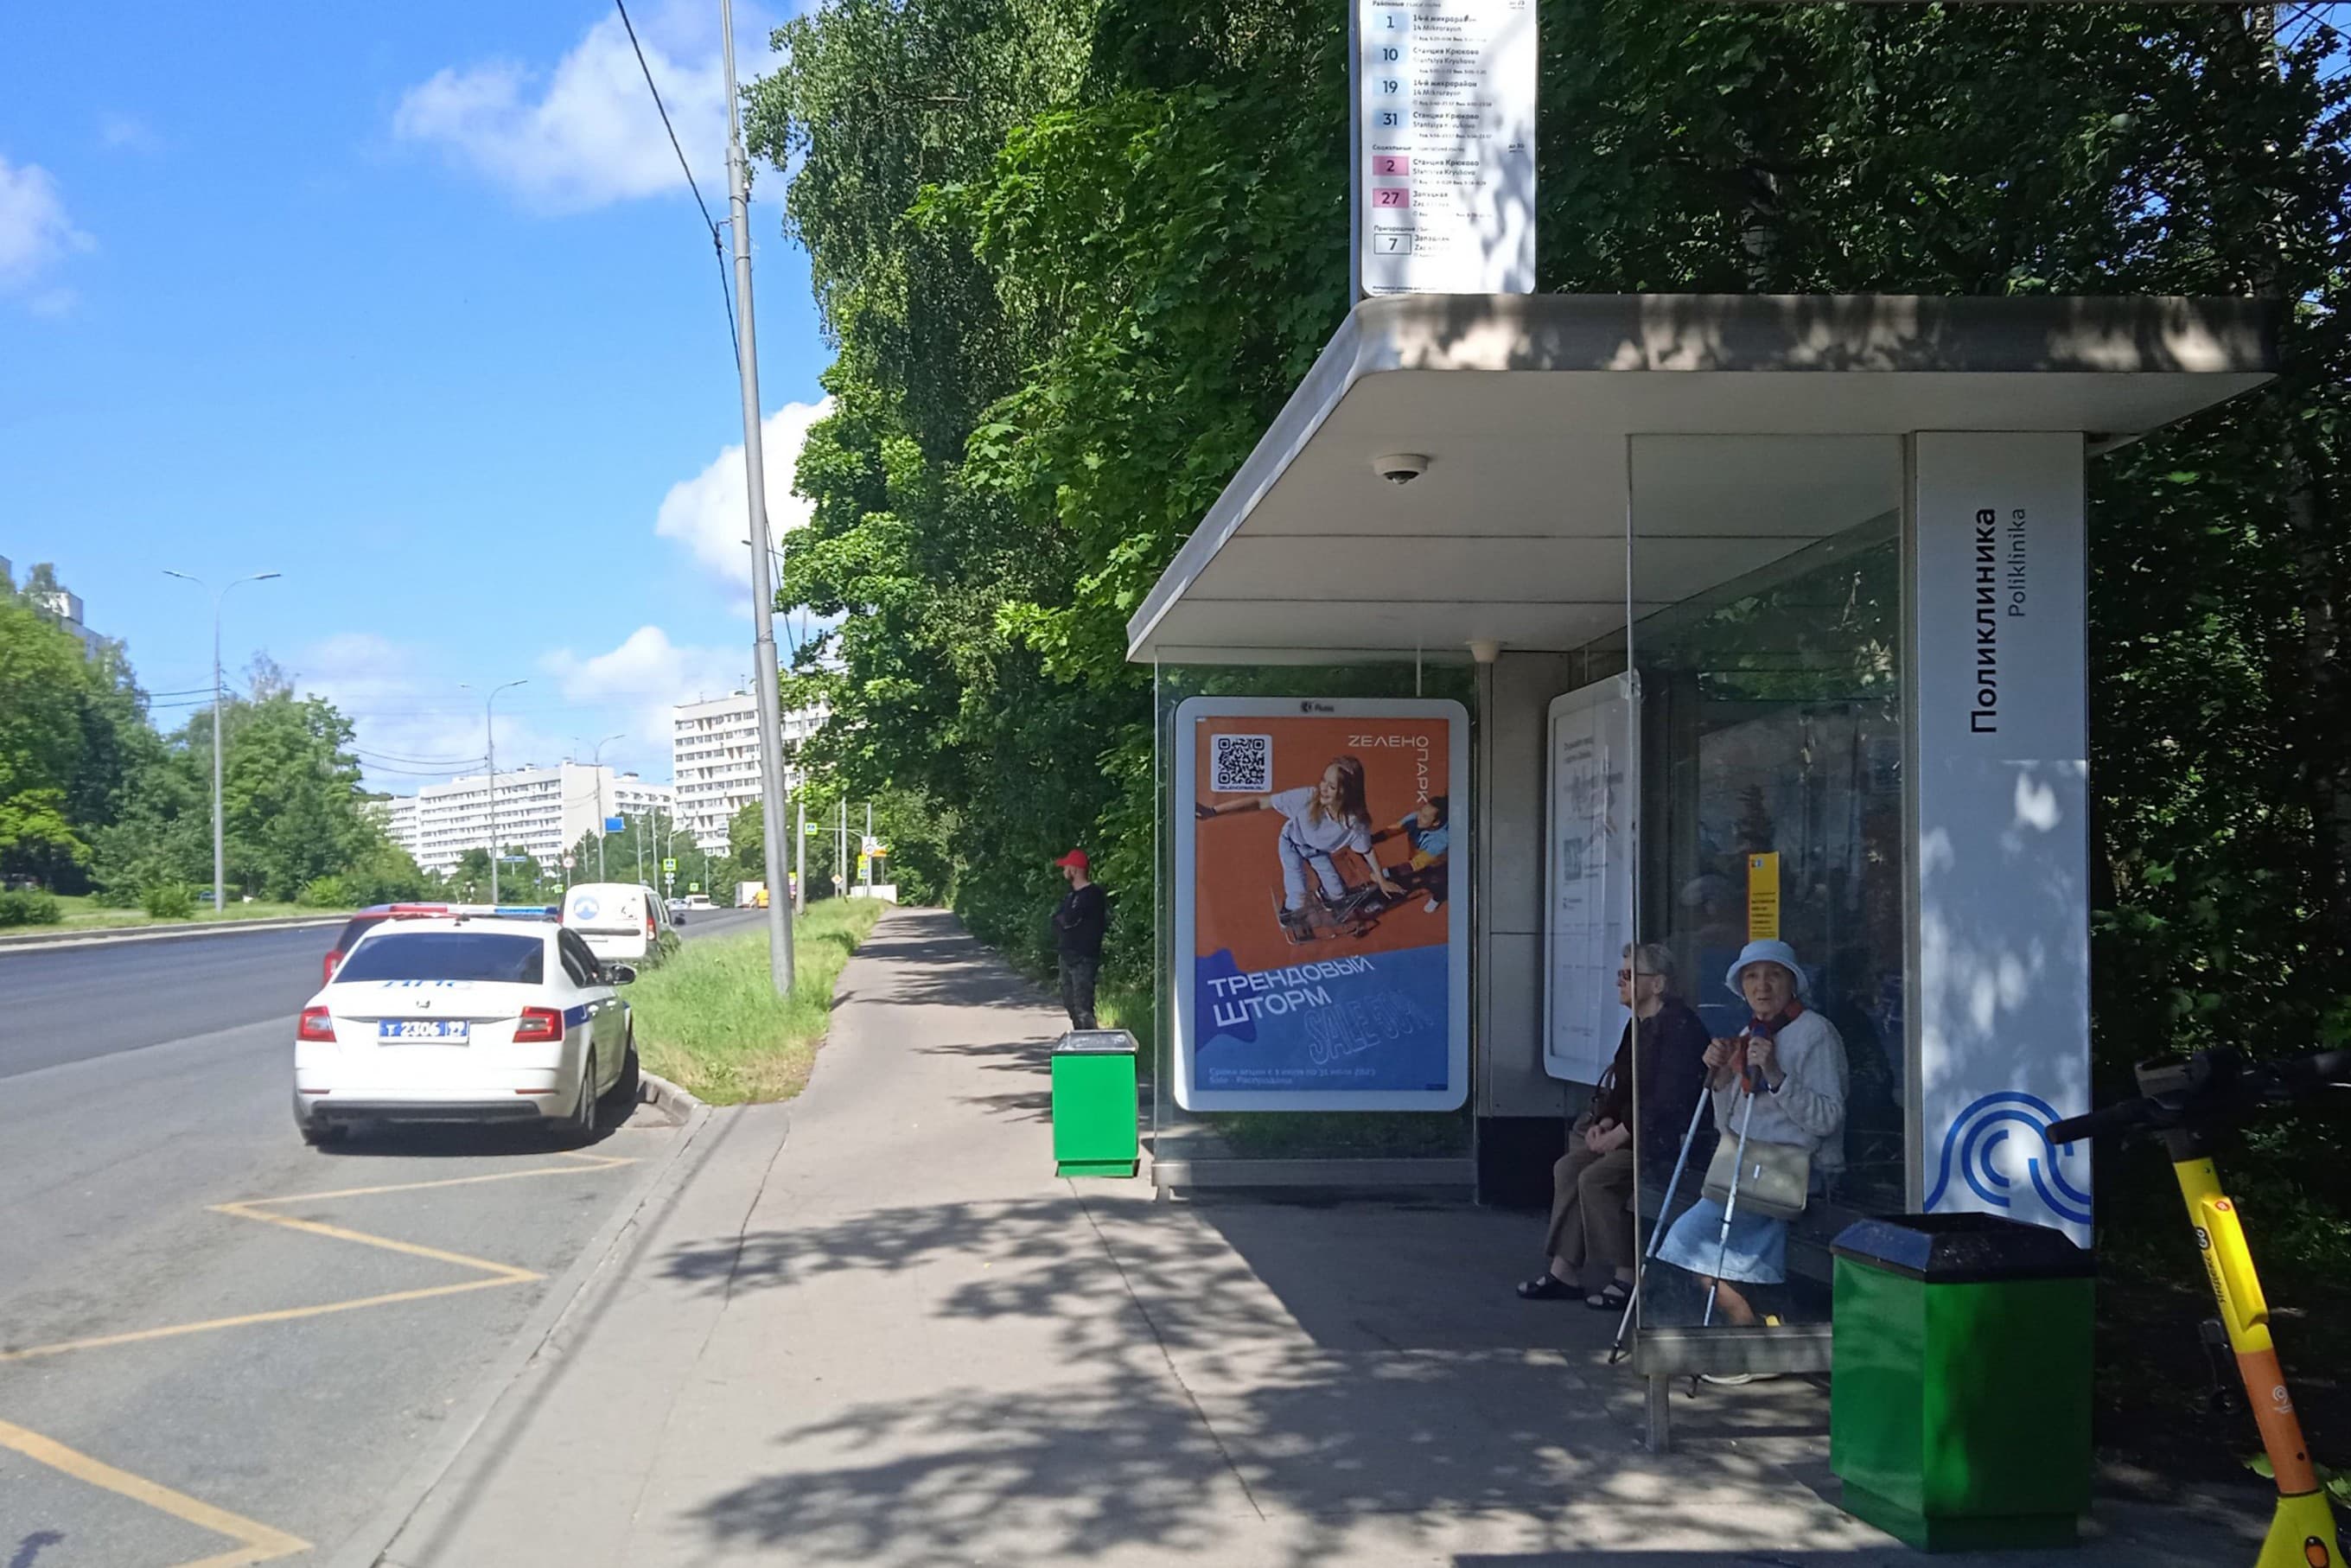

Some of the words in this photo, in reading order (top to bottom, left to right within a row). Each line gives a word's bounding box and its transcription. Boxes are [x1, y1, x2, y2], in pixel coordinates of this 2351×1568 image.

[1386, 16, 1395, 29] 1
[1383, 48, 1398, 61] 10
[1383, 80, 1398, 93] 19
[1383, 112, 1398, 125] 31
[1386, 160, 1395, 172] 2
[1381, 192, 1399, 205] 27
[1388, 238, 1398, 251] 7
[2007, 507, 2026, 617] Poliklinika
[1971, 508, 1997, 733] Поликлиника
[1207, 954, 1376, 998] ТРЕНДОВЫЙ
[1214, 986, 1333, 1028] ШТОРМ
[1303, 1000, 1381, 1066] SALE
